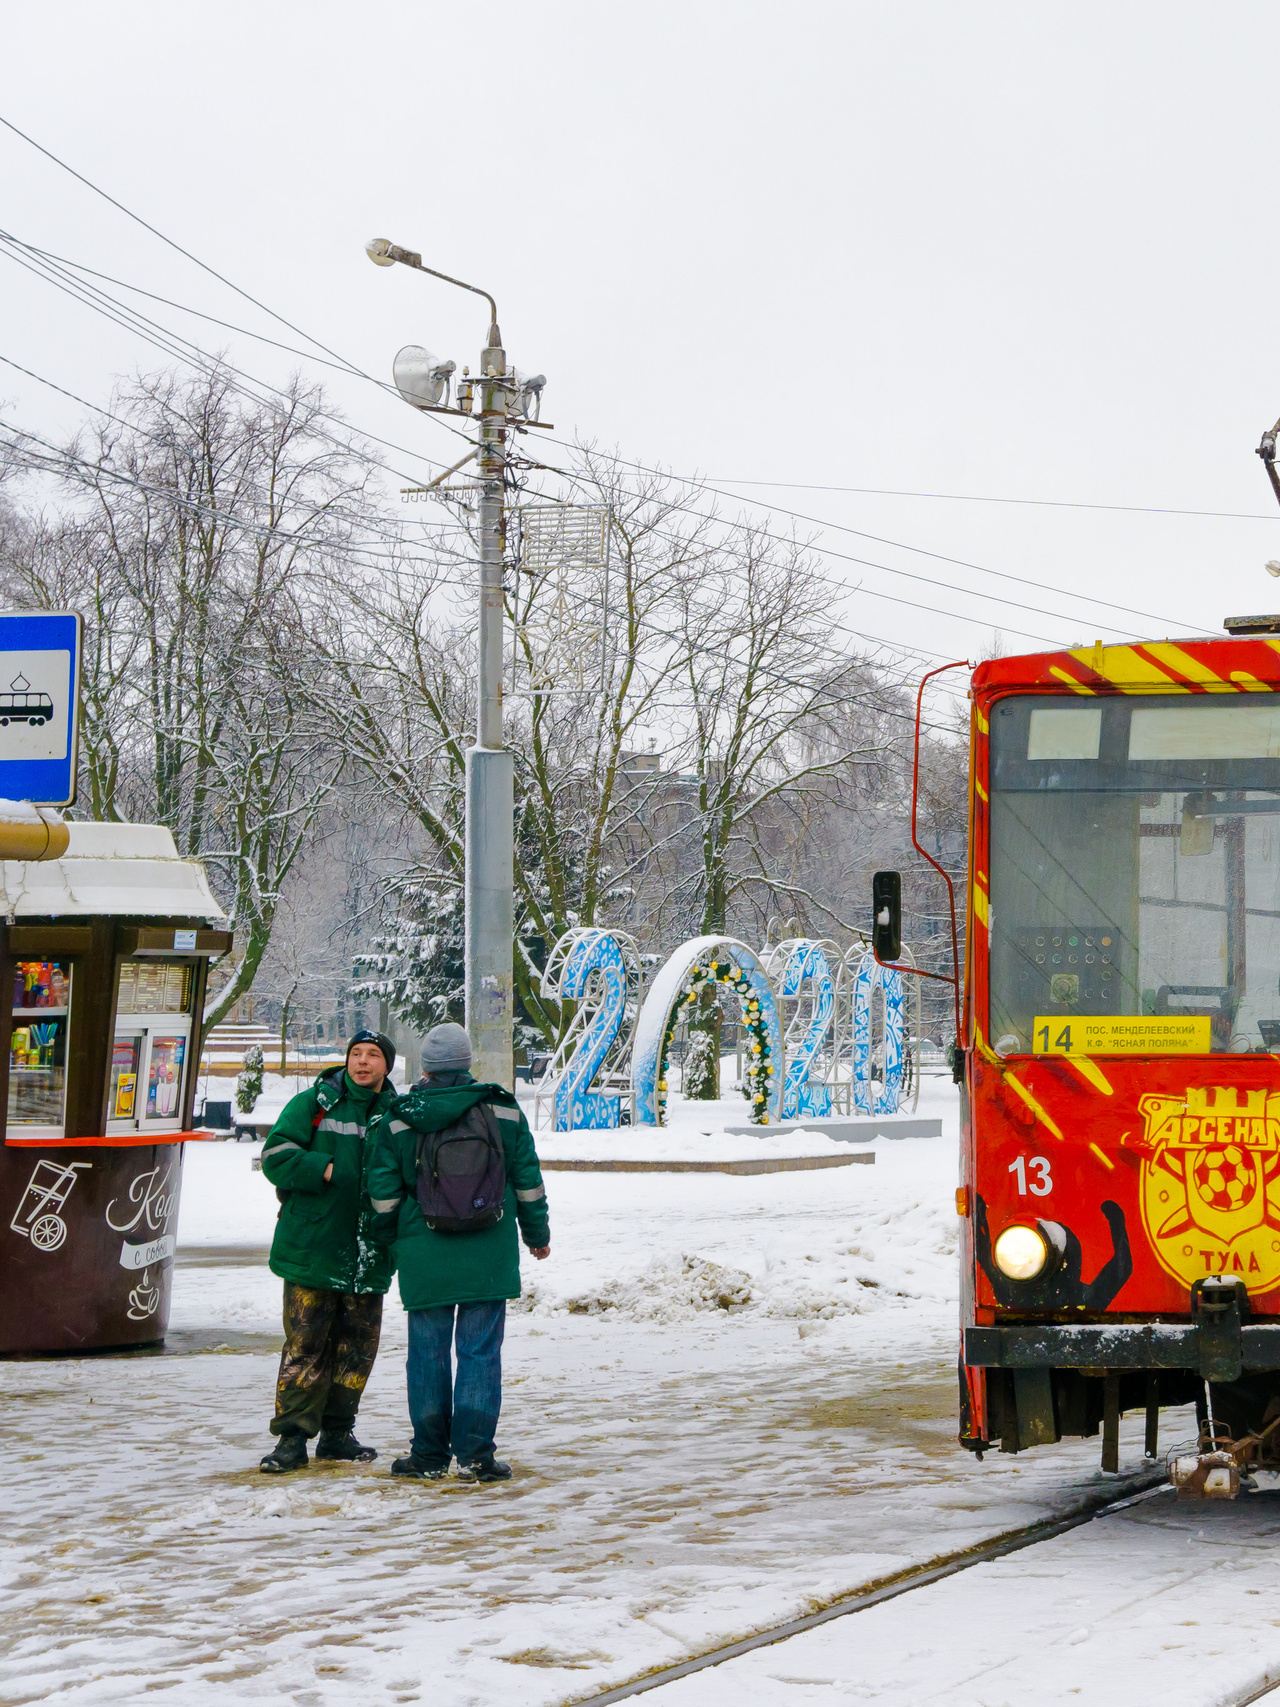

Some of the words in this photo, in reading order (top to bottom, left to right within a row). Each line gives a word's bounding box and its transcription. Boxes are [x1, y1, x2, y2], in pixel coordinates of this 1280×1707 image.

[1036, 1024, 1074, 1052] 14
[1085, 1025, 1109, 1035] ПОС.
[1111, 1024, 1195, 1036] МЕНДЕЛЕЕВСКИЙ
[1086, 1039, 1106, 1048] К.Ф.
[1008, 1155, 1054, 1197] 13
[105, 1162, 177, 1235] Коф
[1199, 1250, 1261, 1273] ТУЛА
